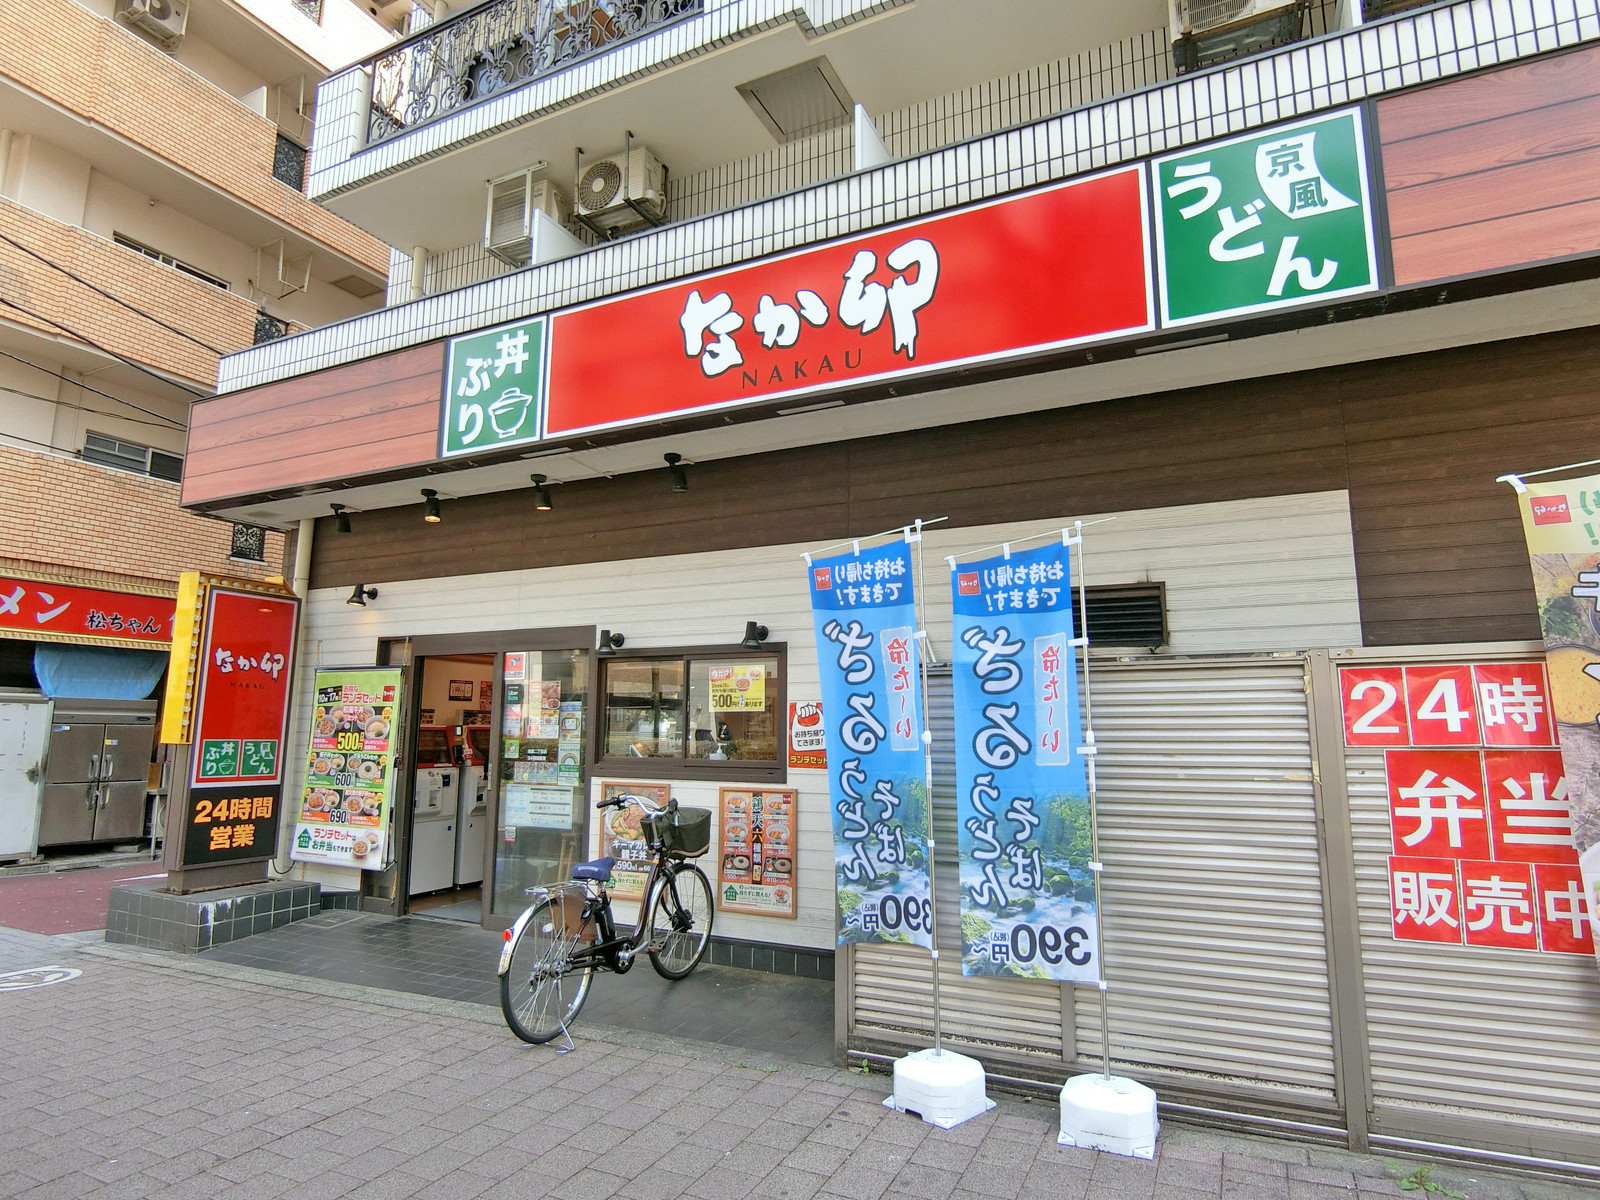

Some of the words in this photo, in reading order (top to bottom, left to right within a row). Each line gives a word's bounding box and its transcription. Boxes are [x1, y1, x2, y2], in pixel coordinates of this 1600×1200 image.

[1265, 143, 1328, 213] 京風
[1167, 161, 1339, 297] うどん
[680, 238, 940, 377] なか卯
[742, 349, 863, 389] NAKAU
[86, 610, 161, 635] 松ちゃん
[215, 647, 285, 681] なか卯
[343, 693, 381, 703] ランチセット
[795, 729, 825, 738] お持ち帰り
[797, 738, 824, 746] できます!
[790, 755, 827, 764] ランチセット
[194, 797, 273, 823] 24時間
[1394, 769, 1577, 850] 弁当
[209, 824, 255, 850] 営業
[621, 850, 647, 860] 親子丼
[1393, 870, 1589, 939] 販売中
